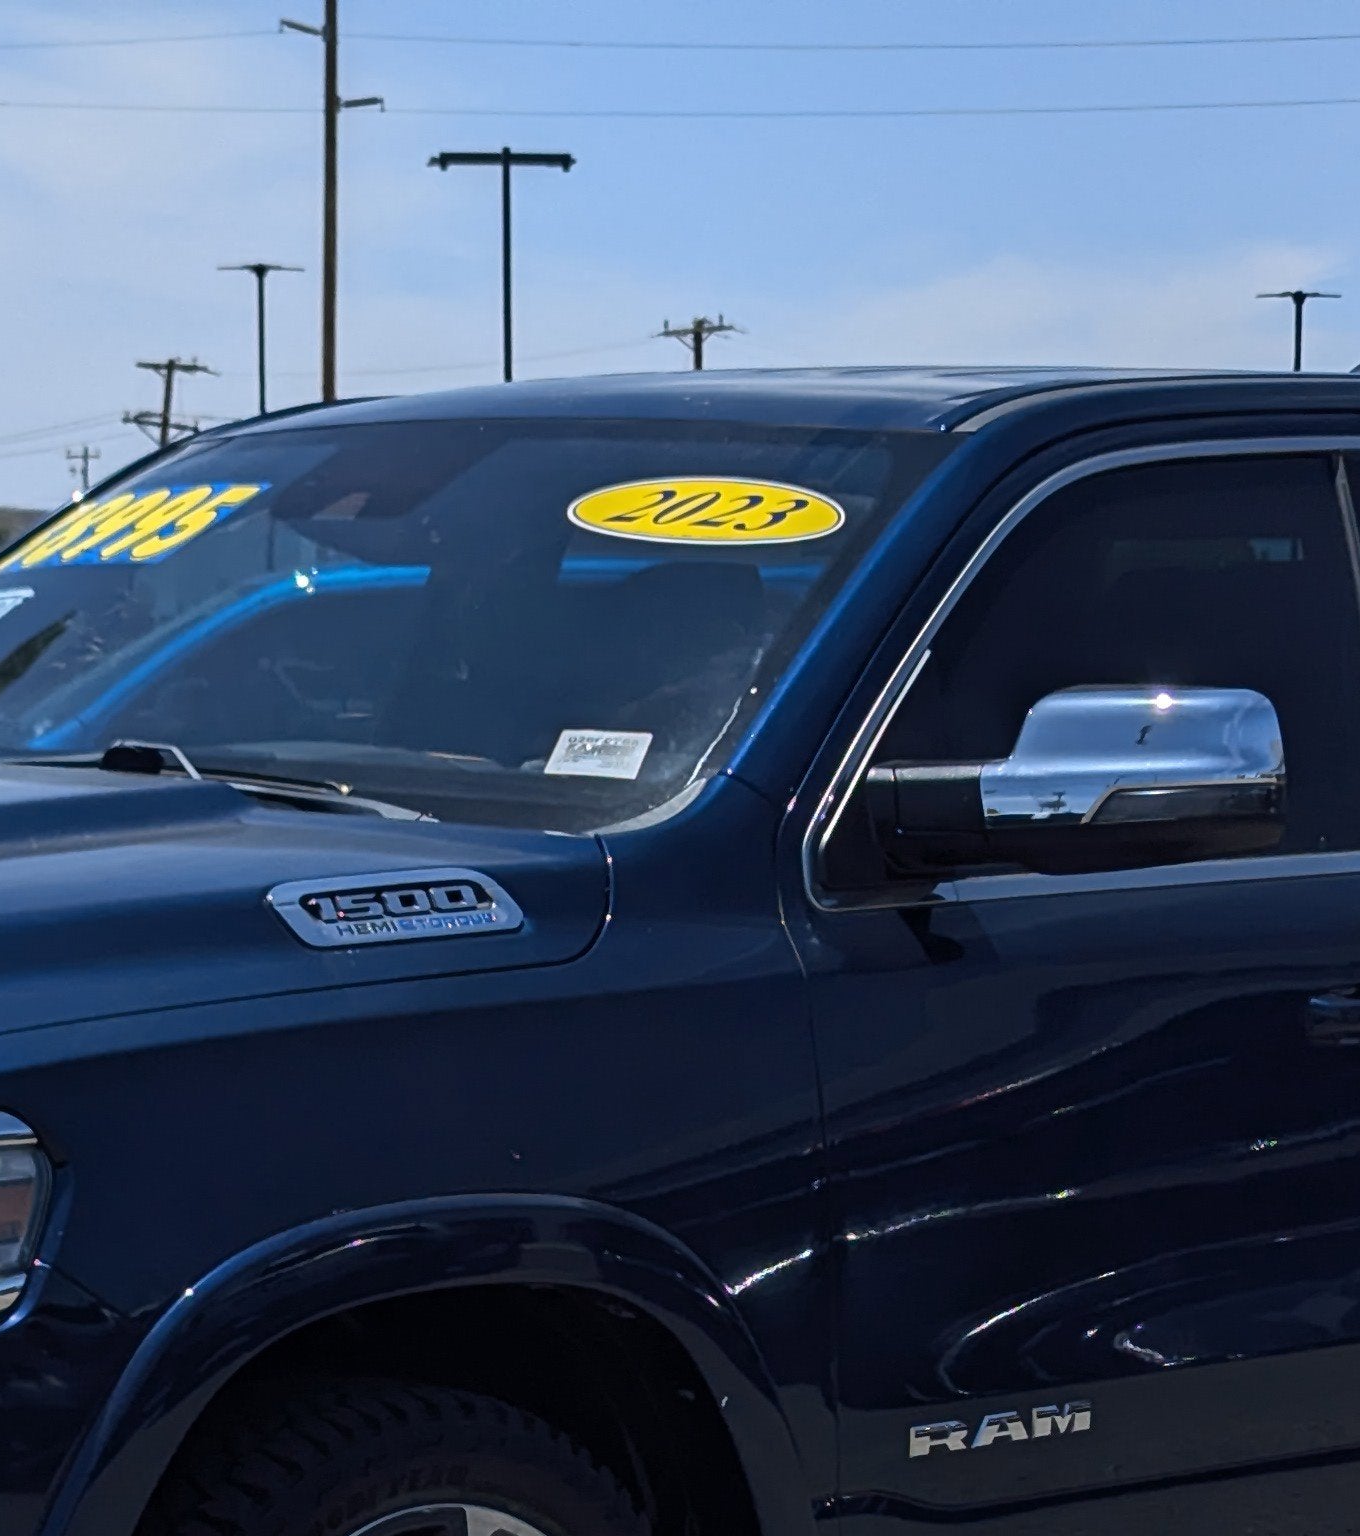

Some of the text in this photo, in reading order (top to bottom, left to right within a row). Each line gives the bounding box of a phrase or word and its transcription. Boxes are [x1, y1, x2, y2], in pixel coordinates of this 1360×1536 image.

[601, 489, 809, 531] 2023
[307, 885, 478, 922] 1500
[336, 919, 399, 937] HEMI
[909, 1401, 1091, 1458] RAM
